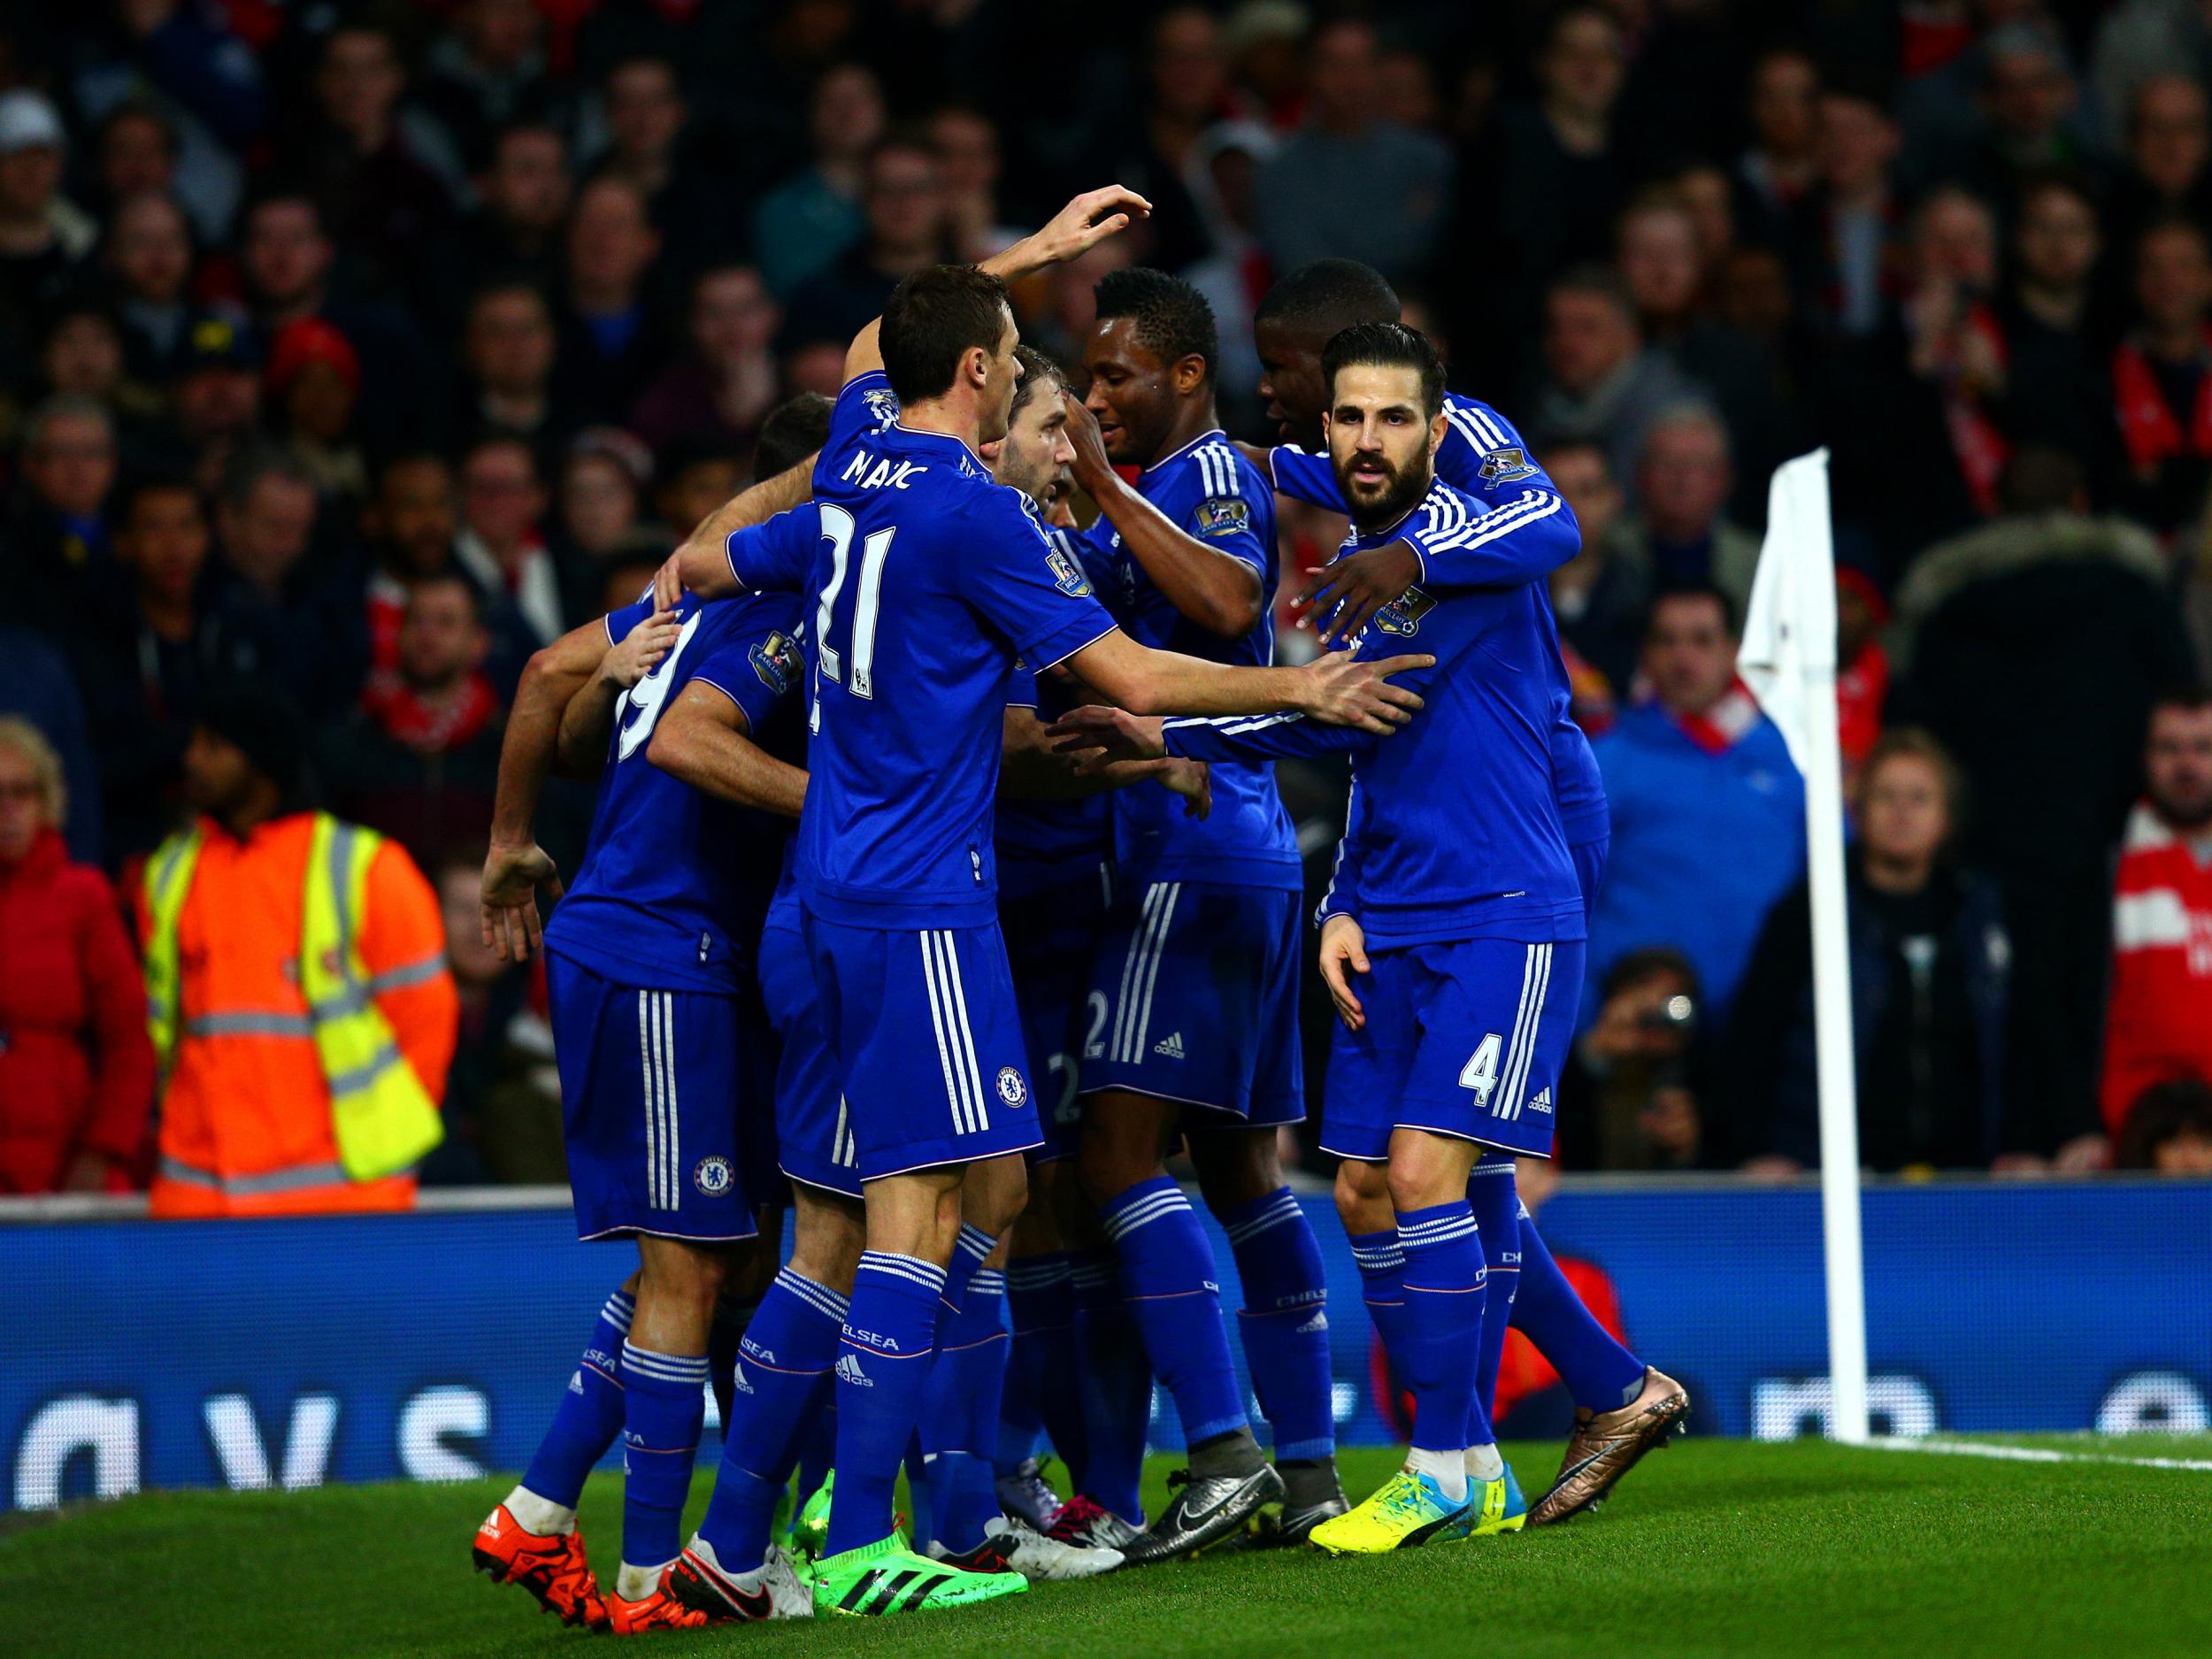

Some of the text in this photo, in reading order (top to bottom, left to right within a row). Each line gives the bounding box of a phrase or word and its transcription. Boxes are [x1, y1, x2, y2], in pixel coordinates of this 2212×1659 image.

[841, 449, 929, 489] MAIC
[817, 502, 896, 700] 21
[615, 608, 703, 764] 9
[1154, 1045, 1185, 1060] adidas
[1458, 1033, 1502, 1107] 4
[1047, 1052, 1081, 1124] 2
[1527, 1101, 1552, 1115] adidas
[842, 1323, 899, 1351] ELSEA
